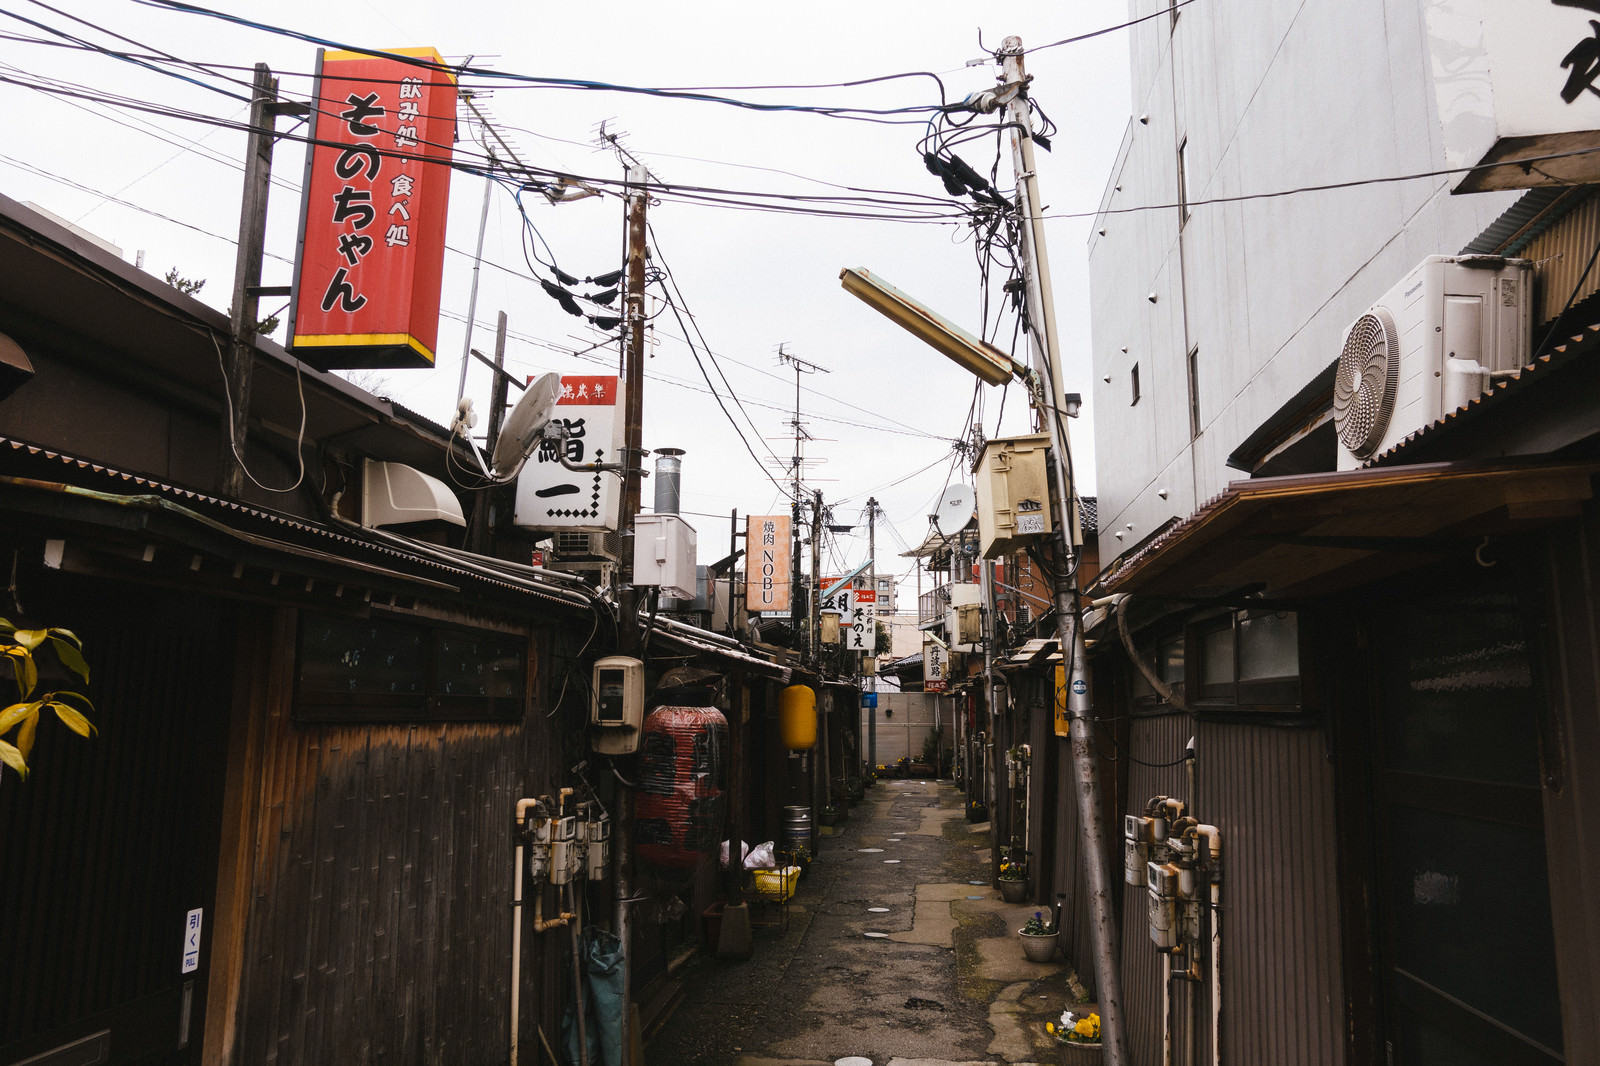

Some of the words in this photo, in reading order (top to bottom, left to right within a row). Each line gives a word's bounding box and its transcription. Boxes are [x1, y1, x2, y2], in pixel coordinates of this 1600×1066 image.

[320, 92, 386, 313] そのちゃん
[763, 521, 775, 546] 焼肉
[762, 550, 774, 604] NOBU
[851, 607, 865, 648] そのえ
[189, 913, 200, 947] 引く
